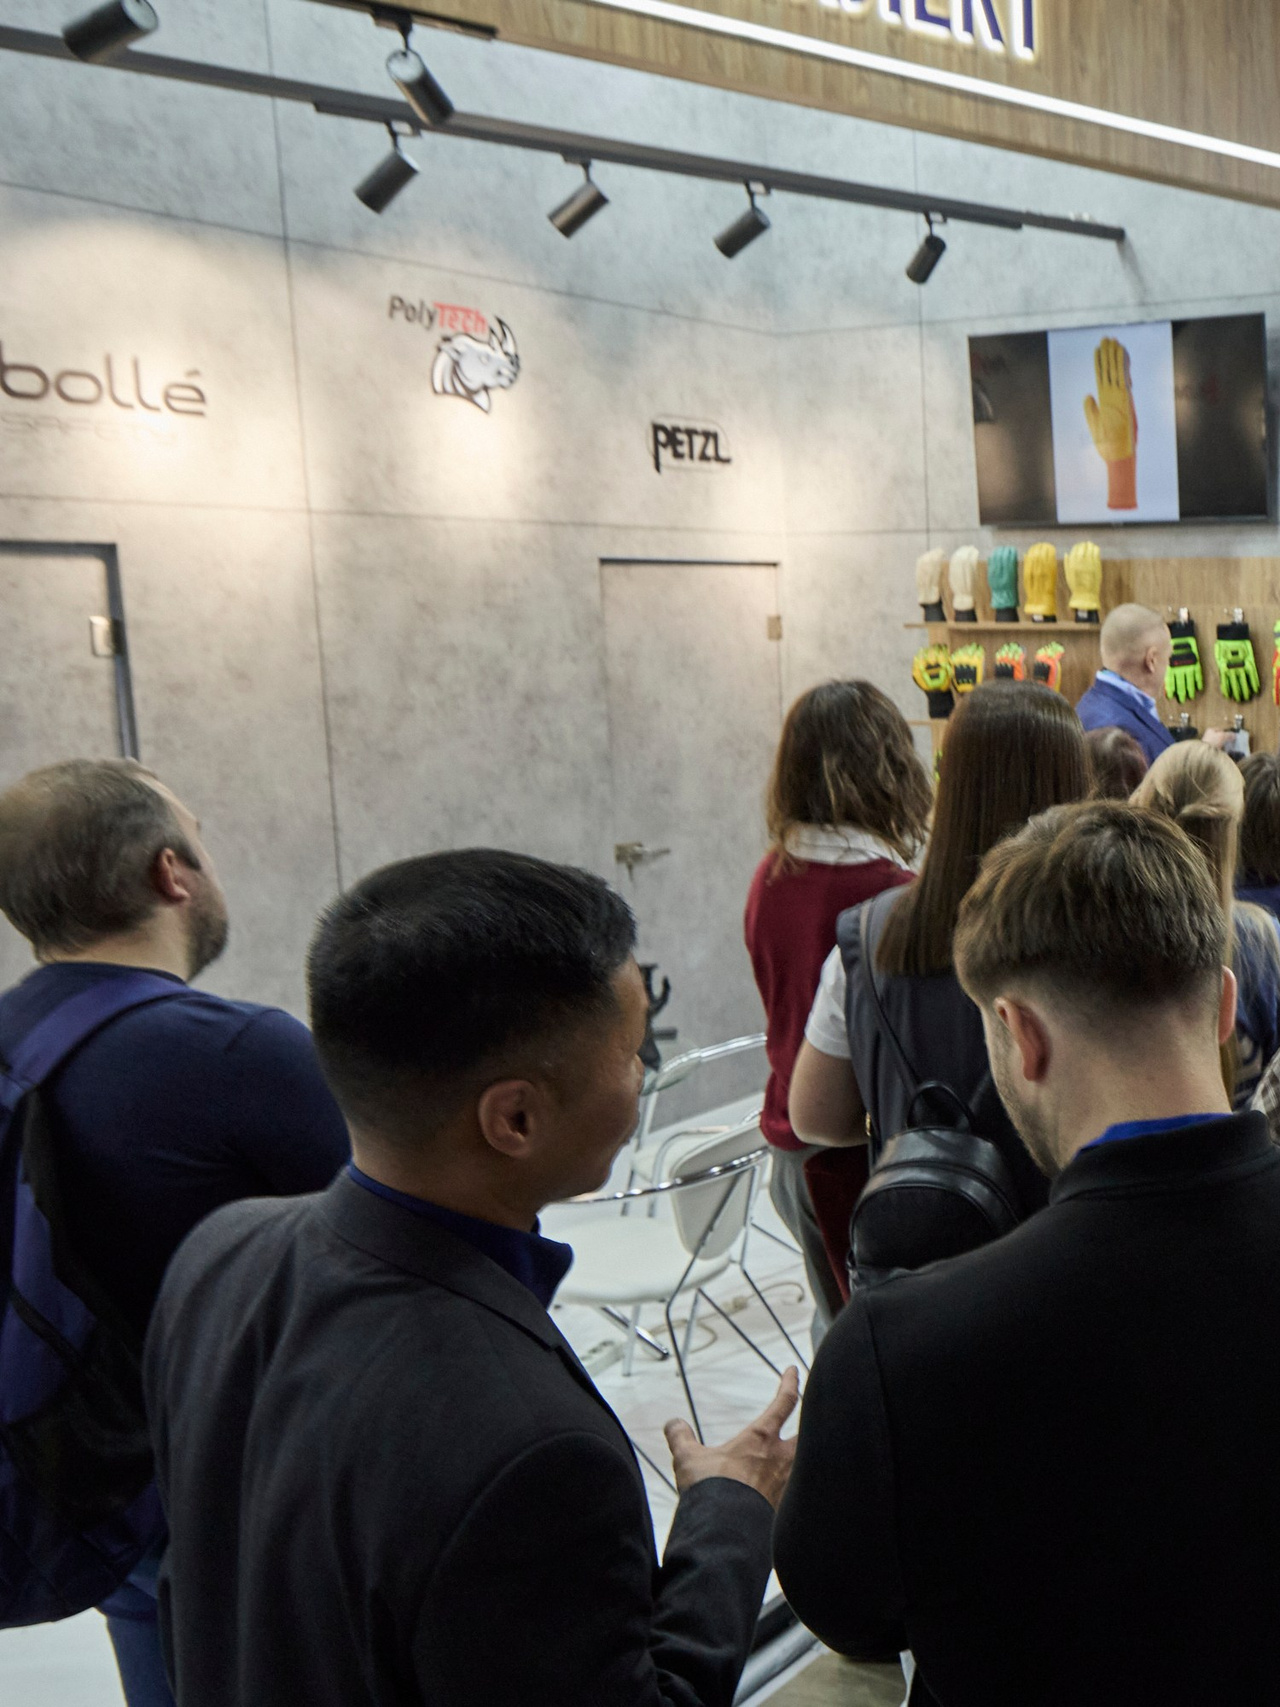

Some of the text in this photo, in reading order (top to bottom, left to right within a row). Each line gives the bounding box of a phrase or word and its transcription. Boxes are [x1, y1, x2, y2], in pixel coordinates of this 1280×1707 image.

[388, 294, 488, 335] PolyTech
[0, 340, 207, 417] bollé
[651, 421, 731, 474] PETZL
